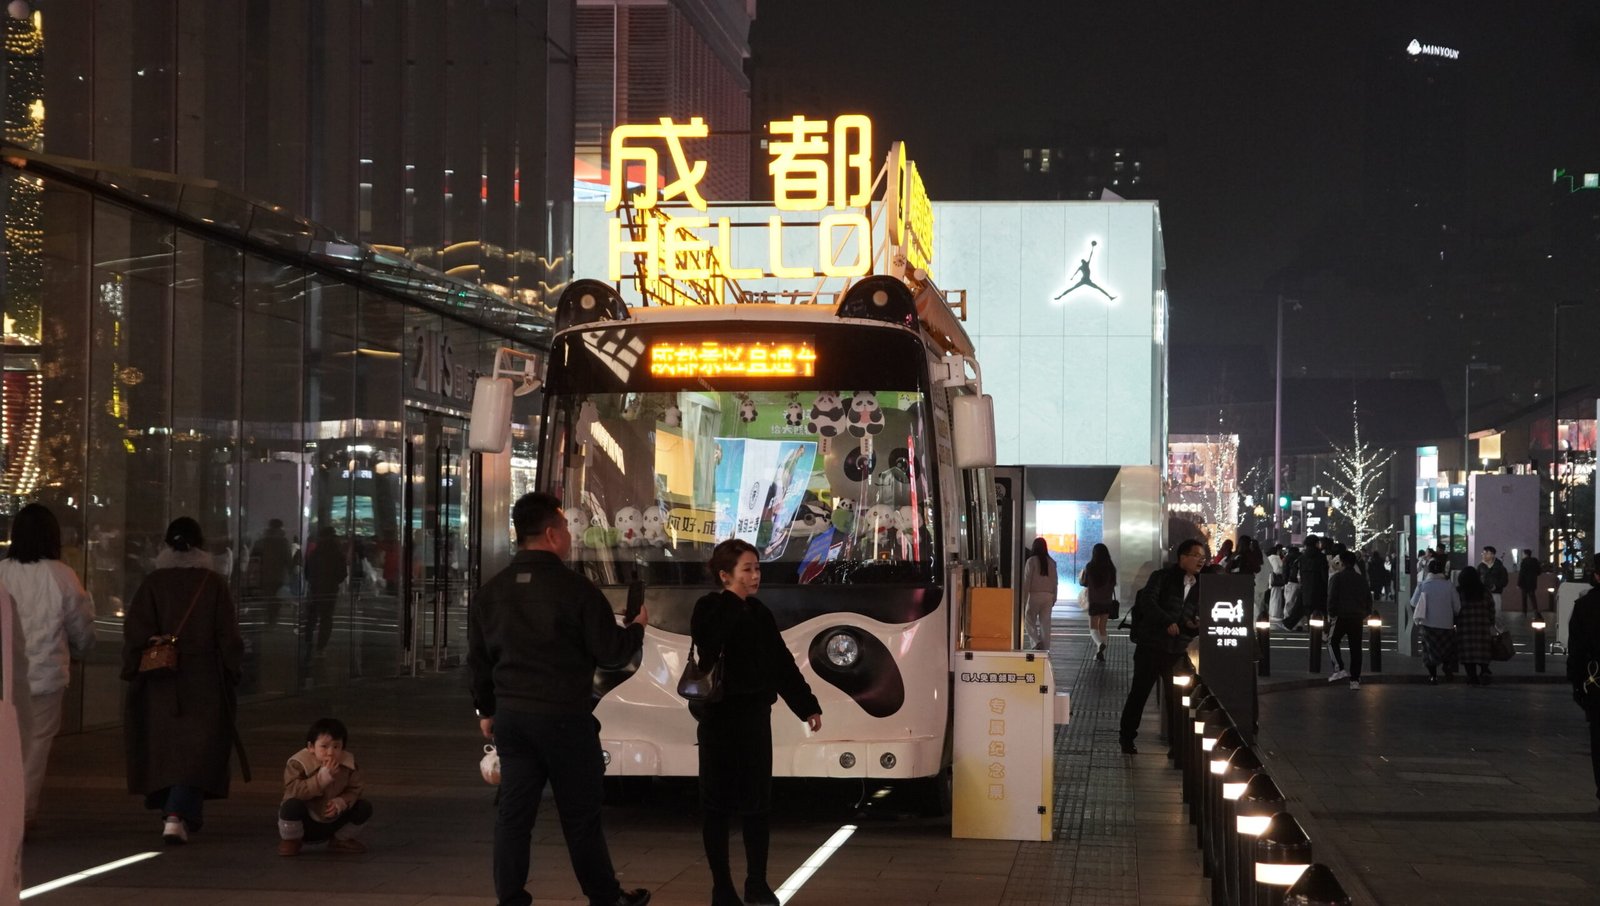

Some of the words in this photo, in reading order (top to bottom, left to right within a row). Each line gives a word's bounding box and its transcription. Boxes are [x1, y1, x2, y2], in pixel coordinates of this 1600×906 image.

[604, 114, 872, 213] 成都
[608, 213, 872, 282] HELLO
[1216, 638, 1223, 647] 2
[1223, 638, 1238, 647] IFS
